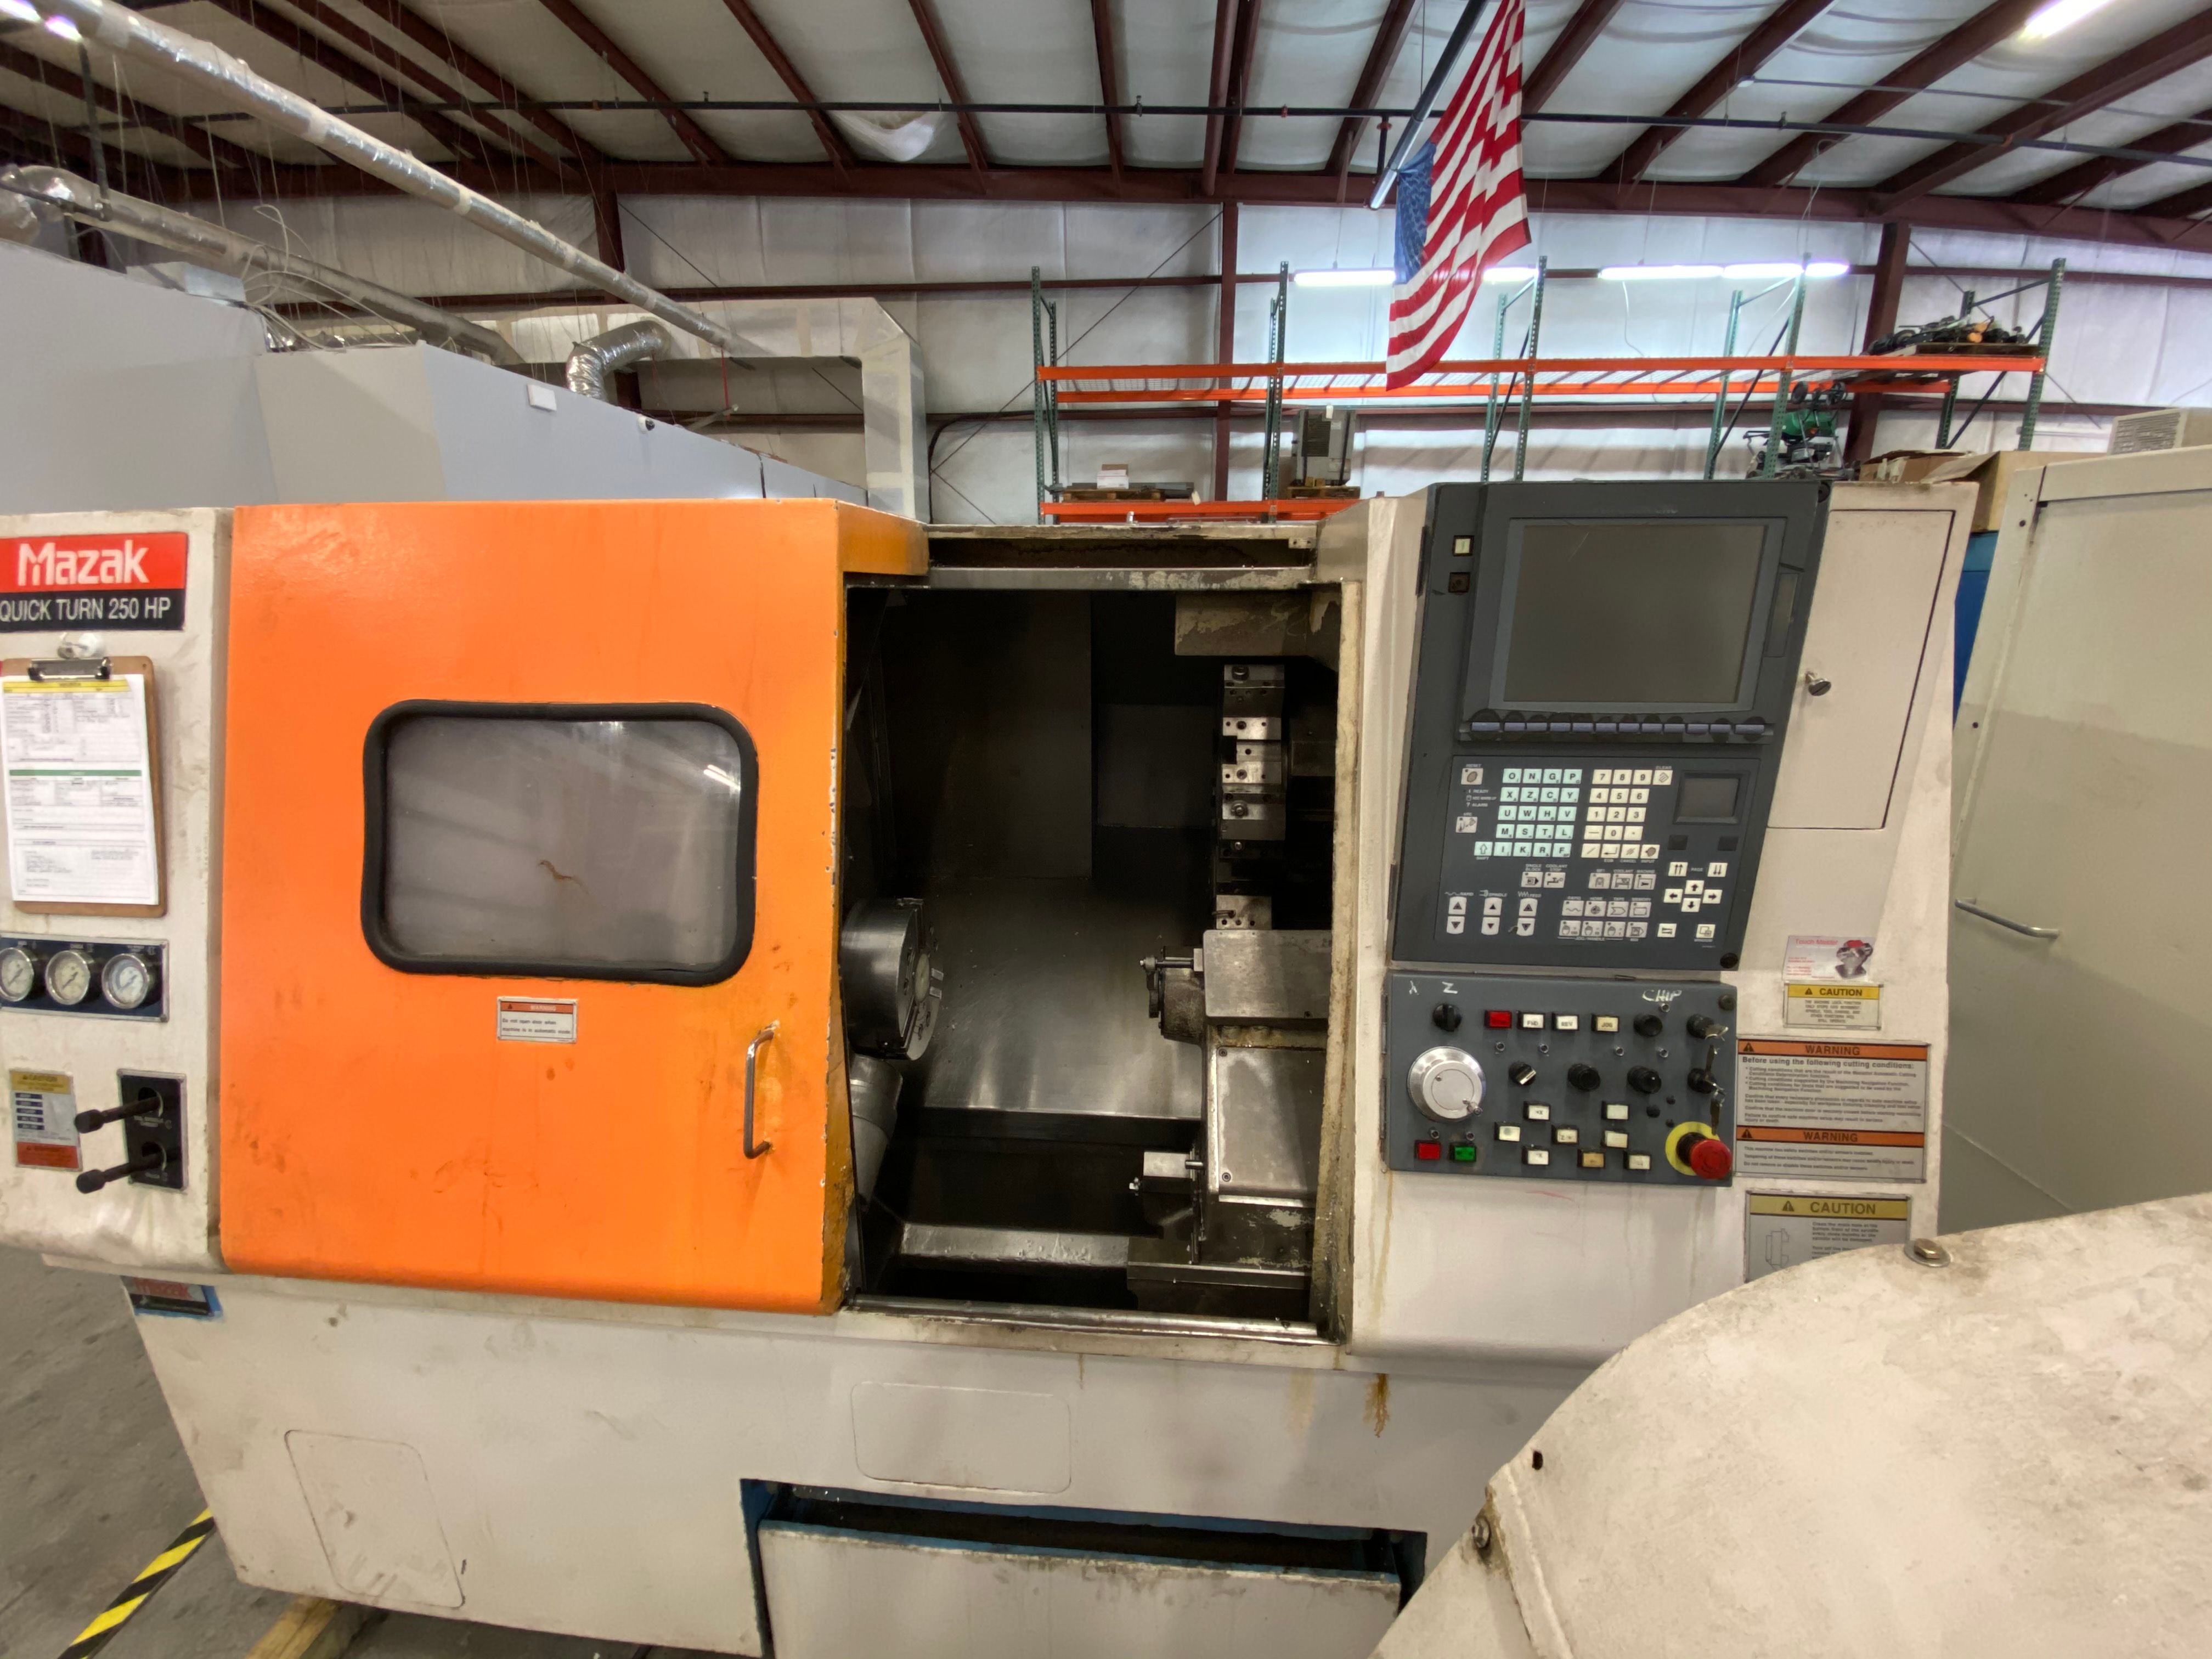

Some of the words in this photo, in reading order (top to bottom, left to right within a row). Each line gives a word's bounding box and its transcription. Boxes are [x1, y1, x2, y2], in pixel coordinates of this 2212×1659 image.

[18, 540, 150, 586] Mazak
[0, 599, 52, 622] QUICK
[56, 597, 104, 620] TURN
[109, 597, 139, 619] 250
[145, 597, 171, 619] HP
[1442, 981, 1458, 994] Z
[1641, 989, 1682, 1002] CHIP
[1805, 1045, 1860, 1056] WARNING
[1807, 1059, 1841, 1067] following
[1804, 1131, 1858, 1142] WARNING
[1810, 1201, 1876, 1215] CAUTION
